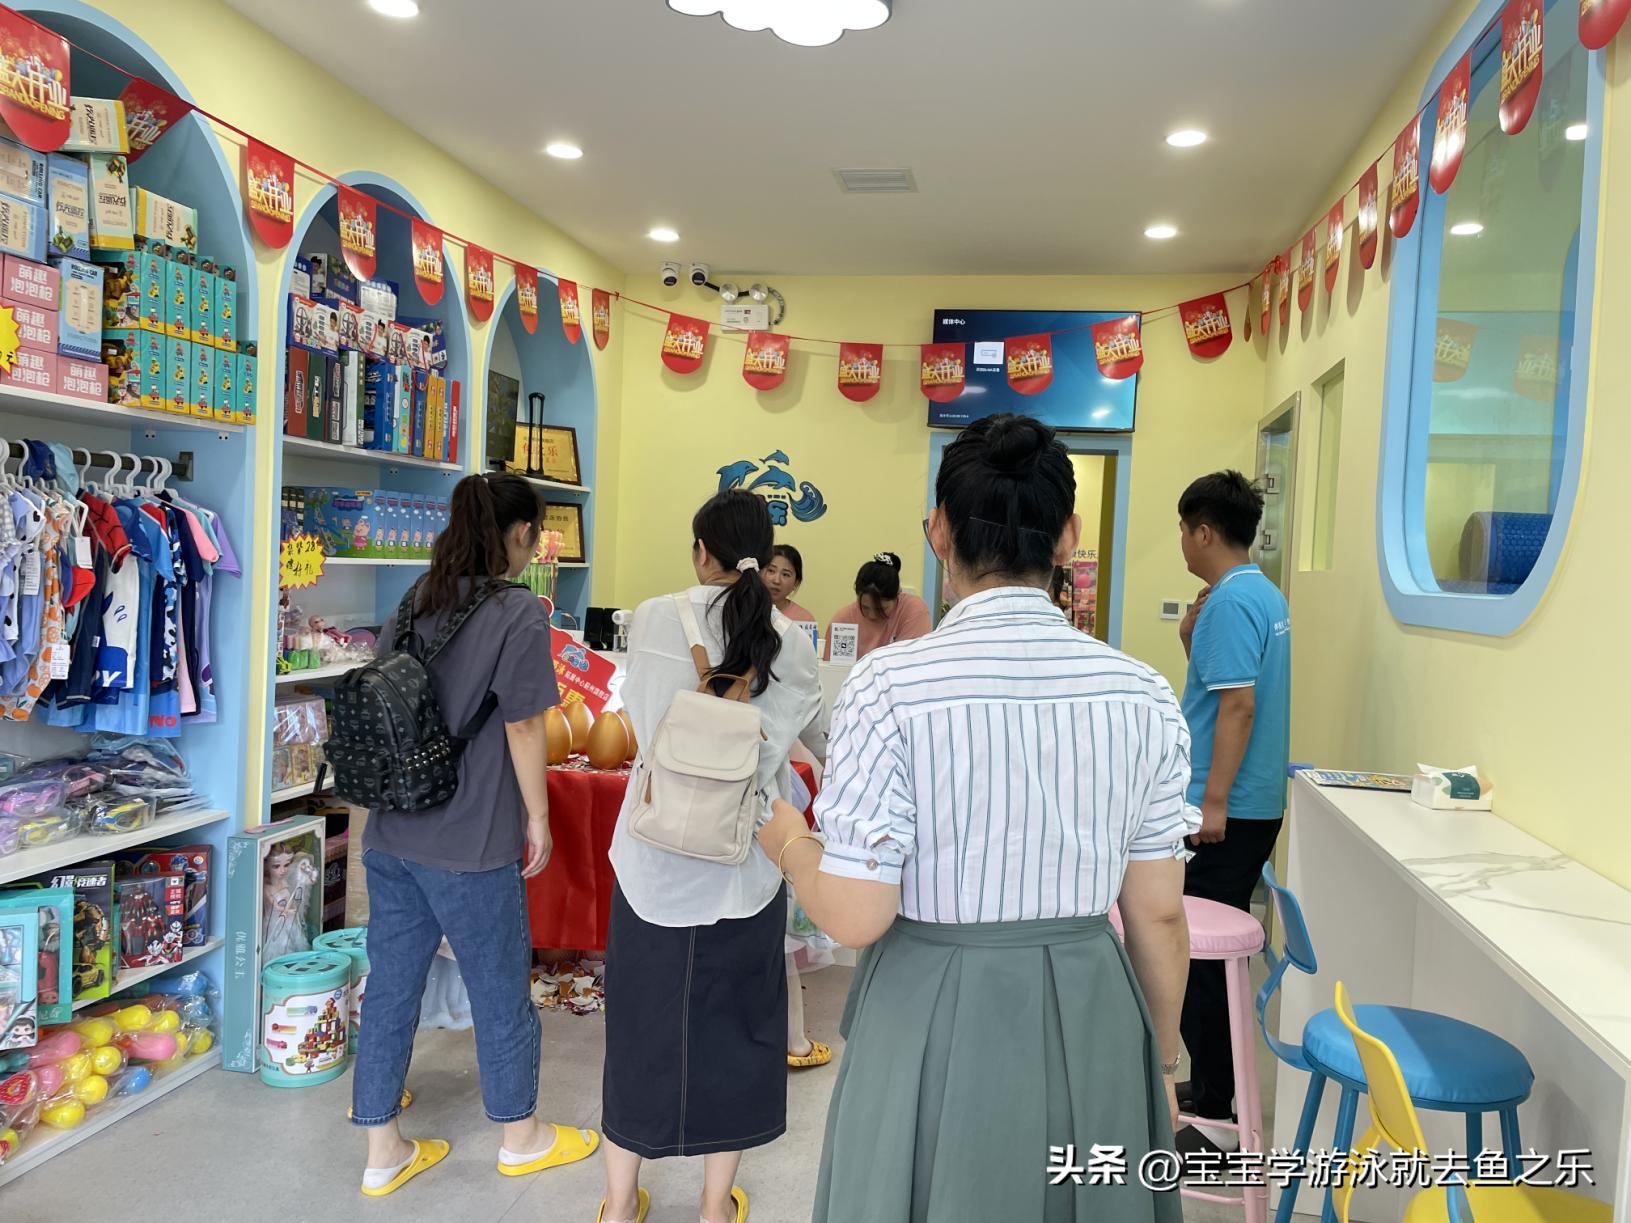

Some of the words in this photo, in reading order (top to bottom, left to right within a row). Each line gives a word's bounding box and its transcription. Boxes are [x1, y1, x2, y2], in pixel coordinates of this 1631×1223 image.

[18, 264, 48, 284] 萌趣
[11, 277, 53, 301] 泡泡枪
[16, 308, 45, 328] 萌趣
[18, 325, 51, 344] 泡枪
[70, 363, 97, 381] 萌趣
[64, 377, 102, 396] 泡泡枪
[1073, 550, 1097, 559] 快乐
